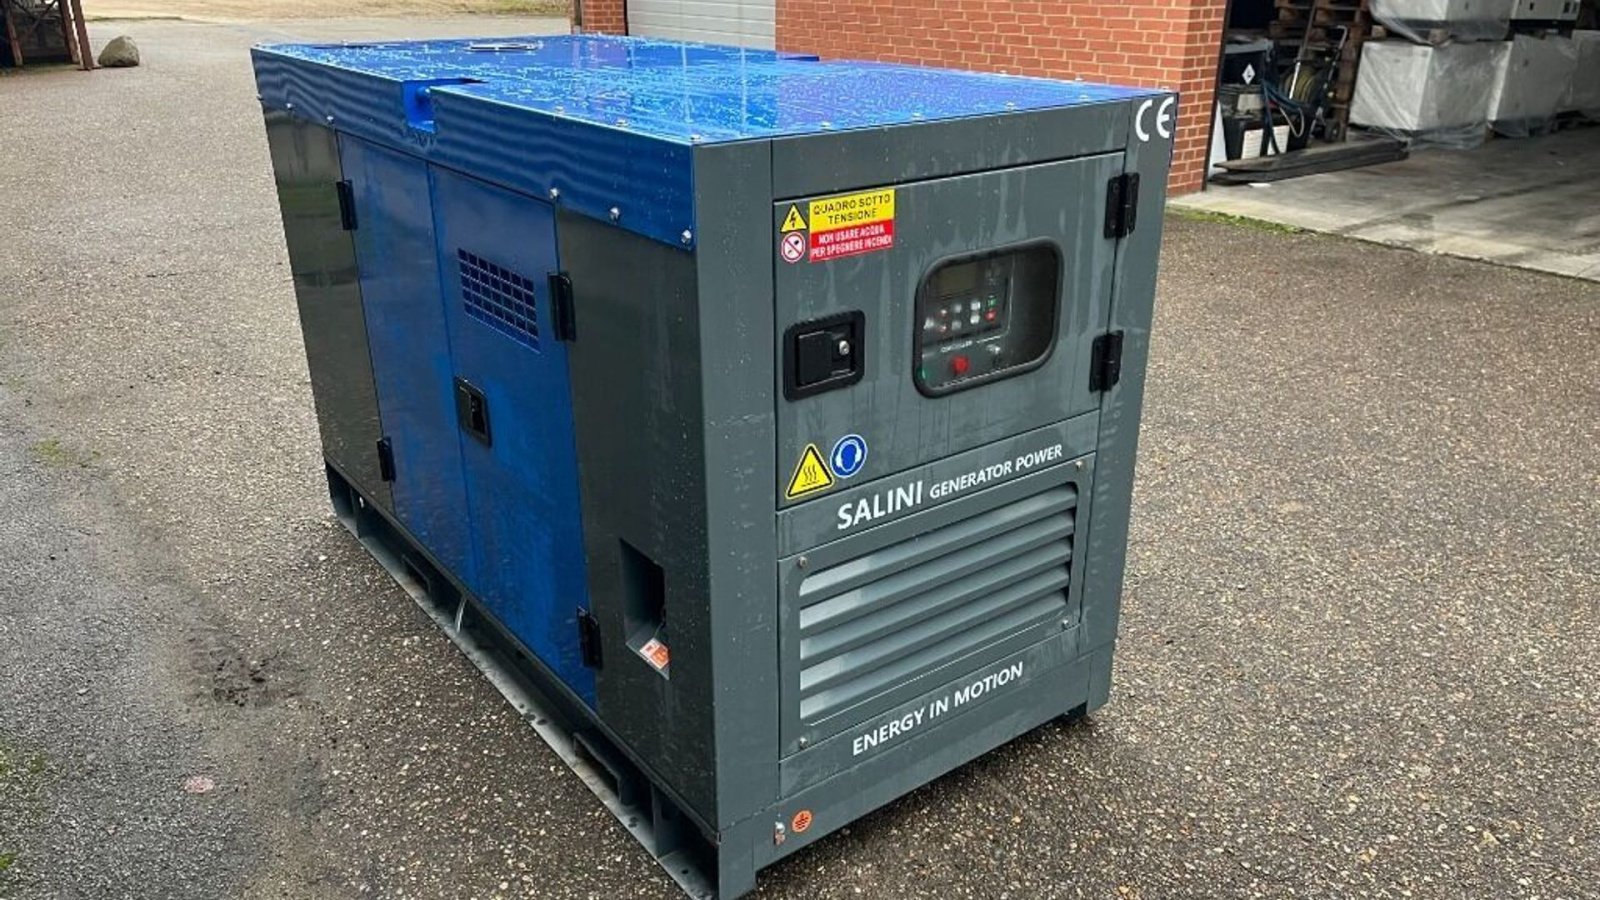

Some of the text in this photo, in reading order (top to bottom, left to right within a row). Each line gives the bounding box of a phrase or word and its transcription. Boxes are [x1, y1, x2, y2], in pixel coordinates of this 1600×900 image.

[813, 193, 891, 215] QUADRO SOTTO
[828, 208, 877, 225] TENSIONE
[818, 224, 885, 244] NON USARE ACQUA
[811, 235, 892, 258] PER SPEGNERE INCENDI
[836, 443, 1063, 530] SALINI GENERATOR POWER
[852, 661, 1023, 756] ENERGY IN MOTION
